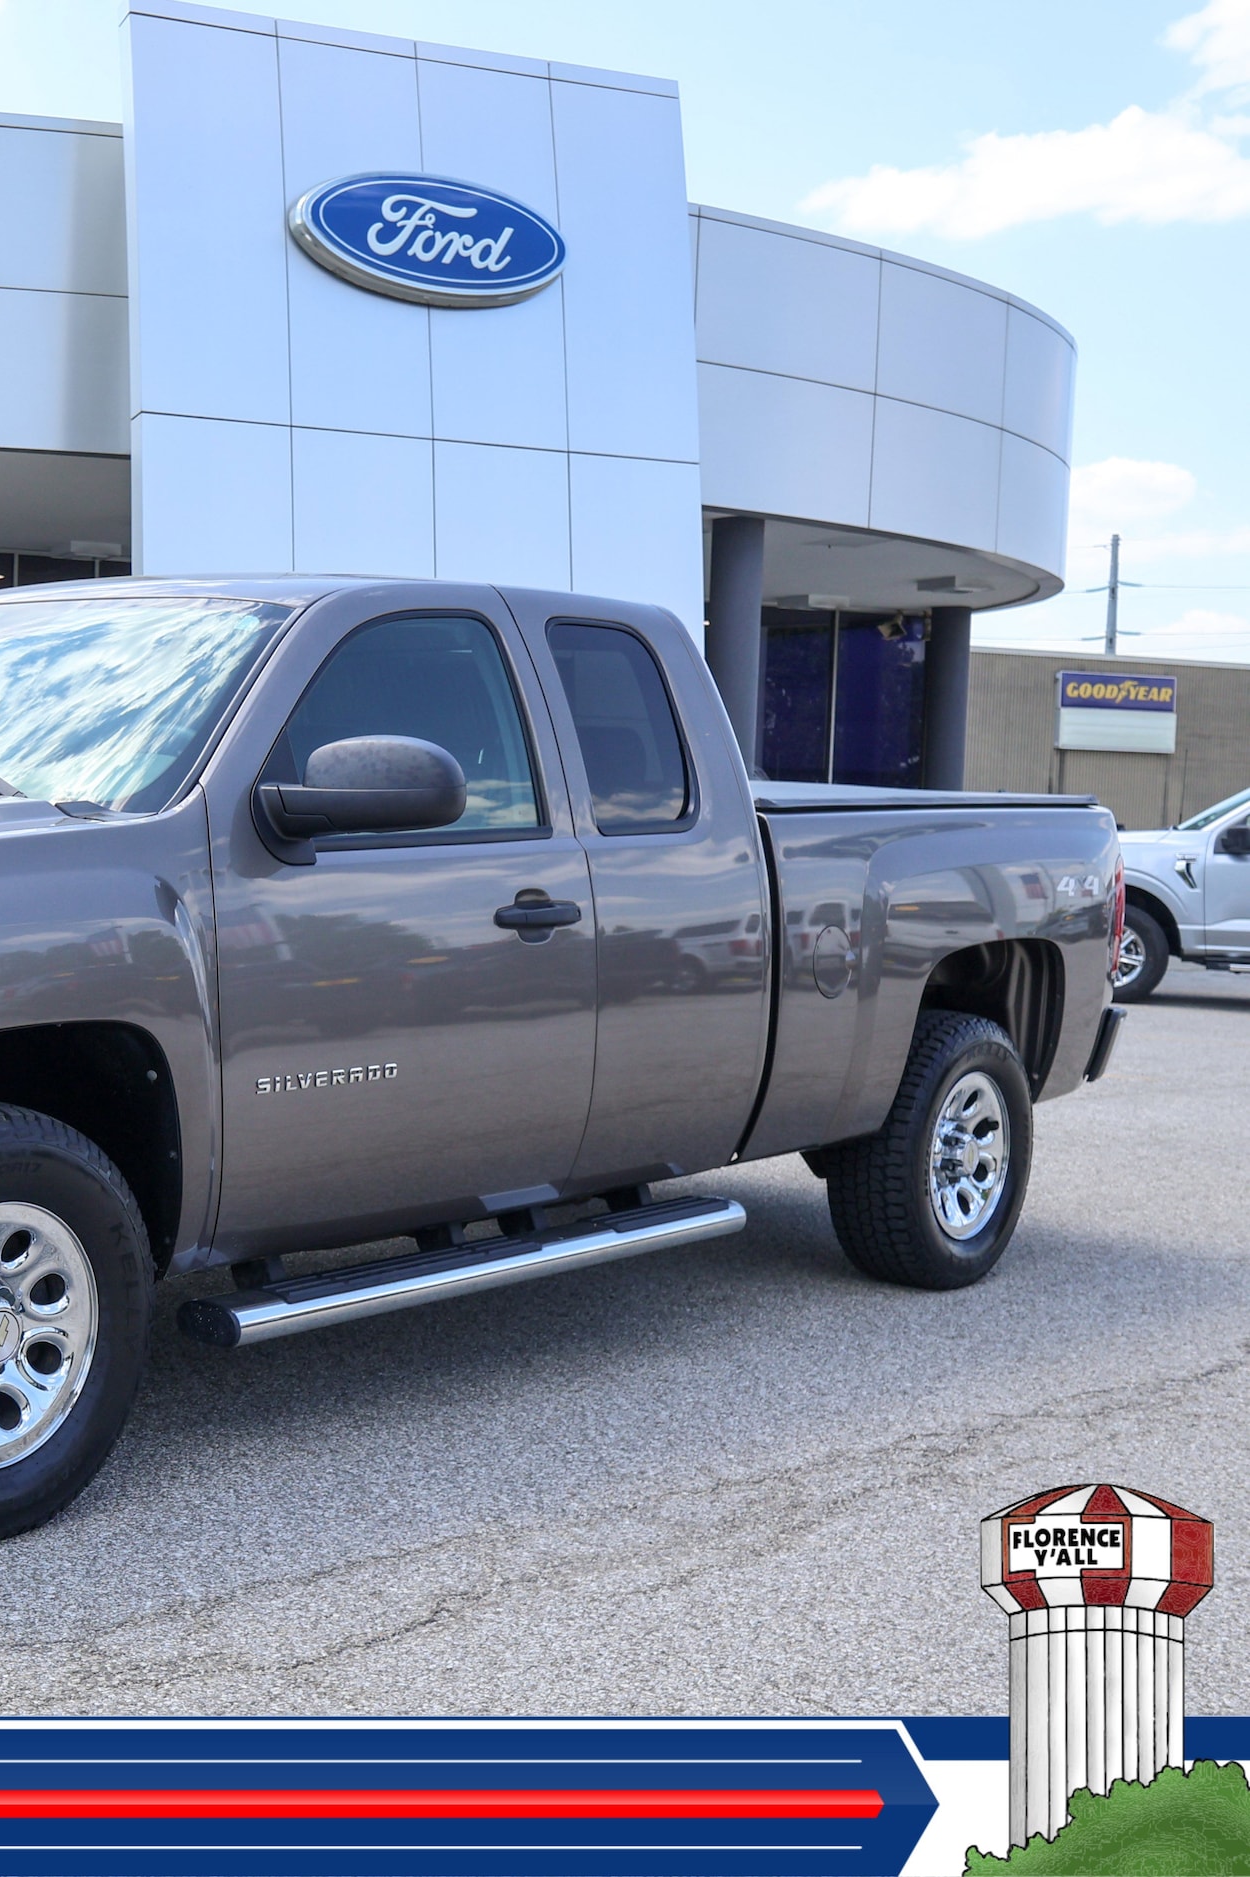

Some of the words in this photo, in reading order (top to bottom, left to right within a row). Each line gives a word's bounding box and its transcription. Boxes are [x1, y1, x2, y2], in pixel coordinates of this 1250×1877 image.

[367, 194, 514, 272] Ford
[1066, 682, 1173, 702] GOODYEAR
[255, 1062, 398, 1095] SILVERADO
